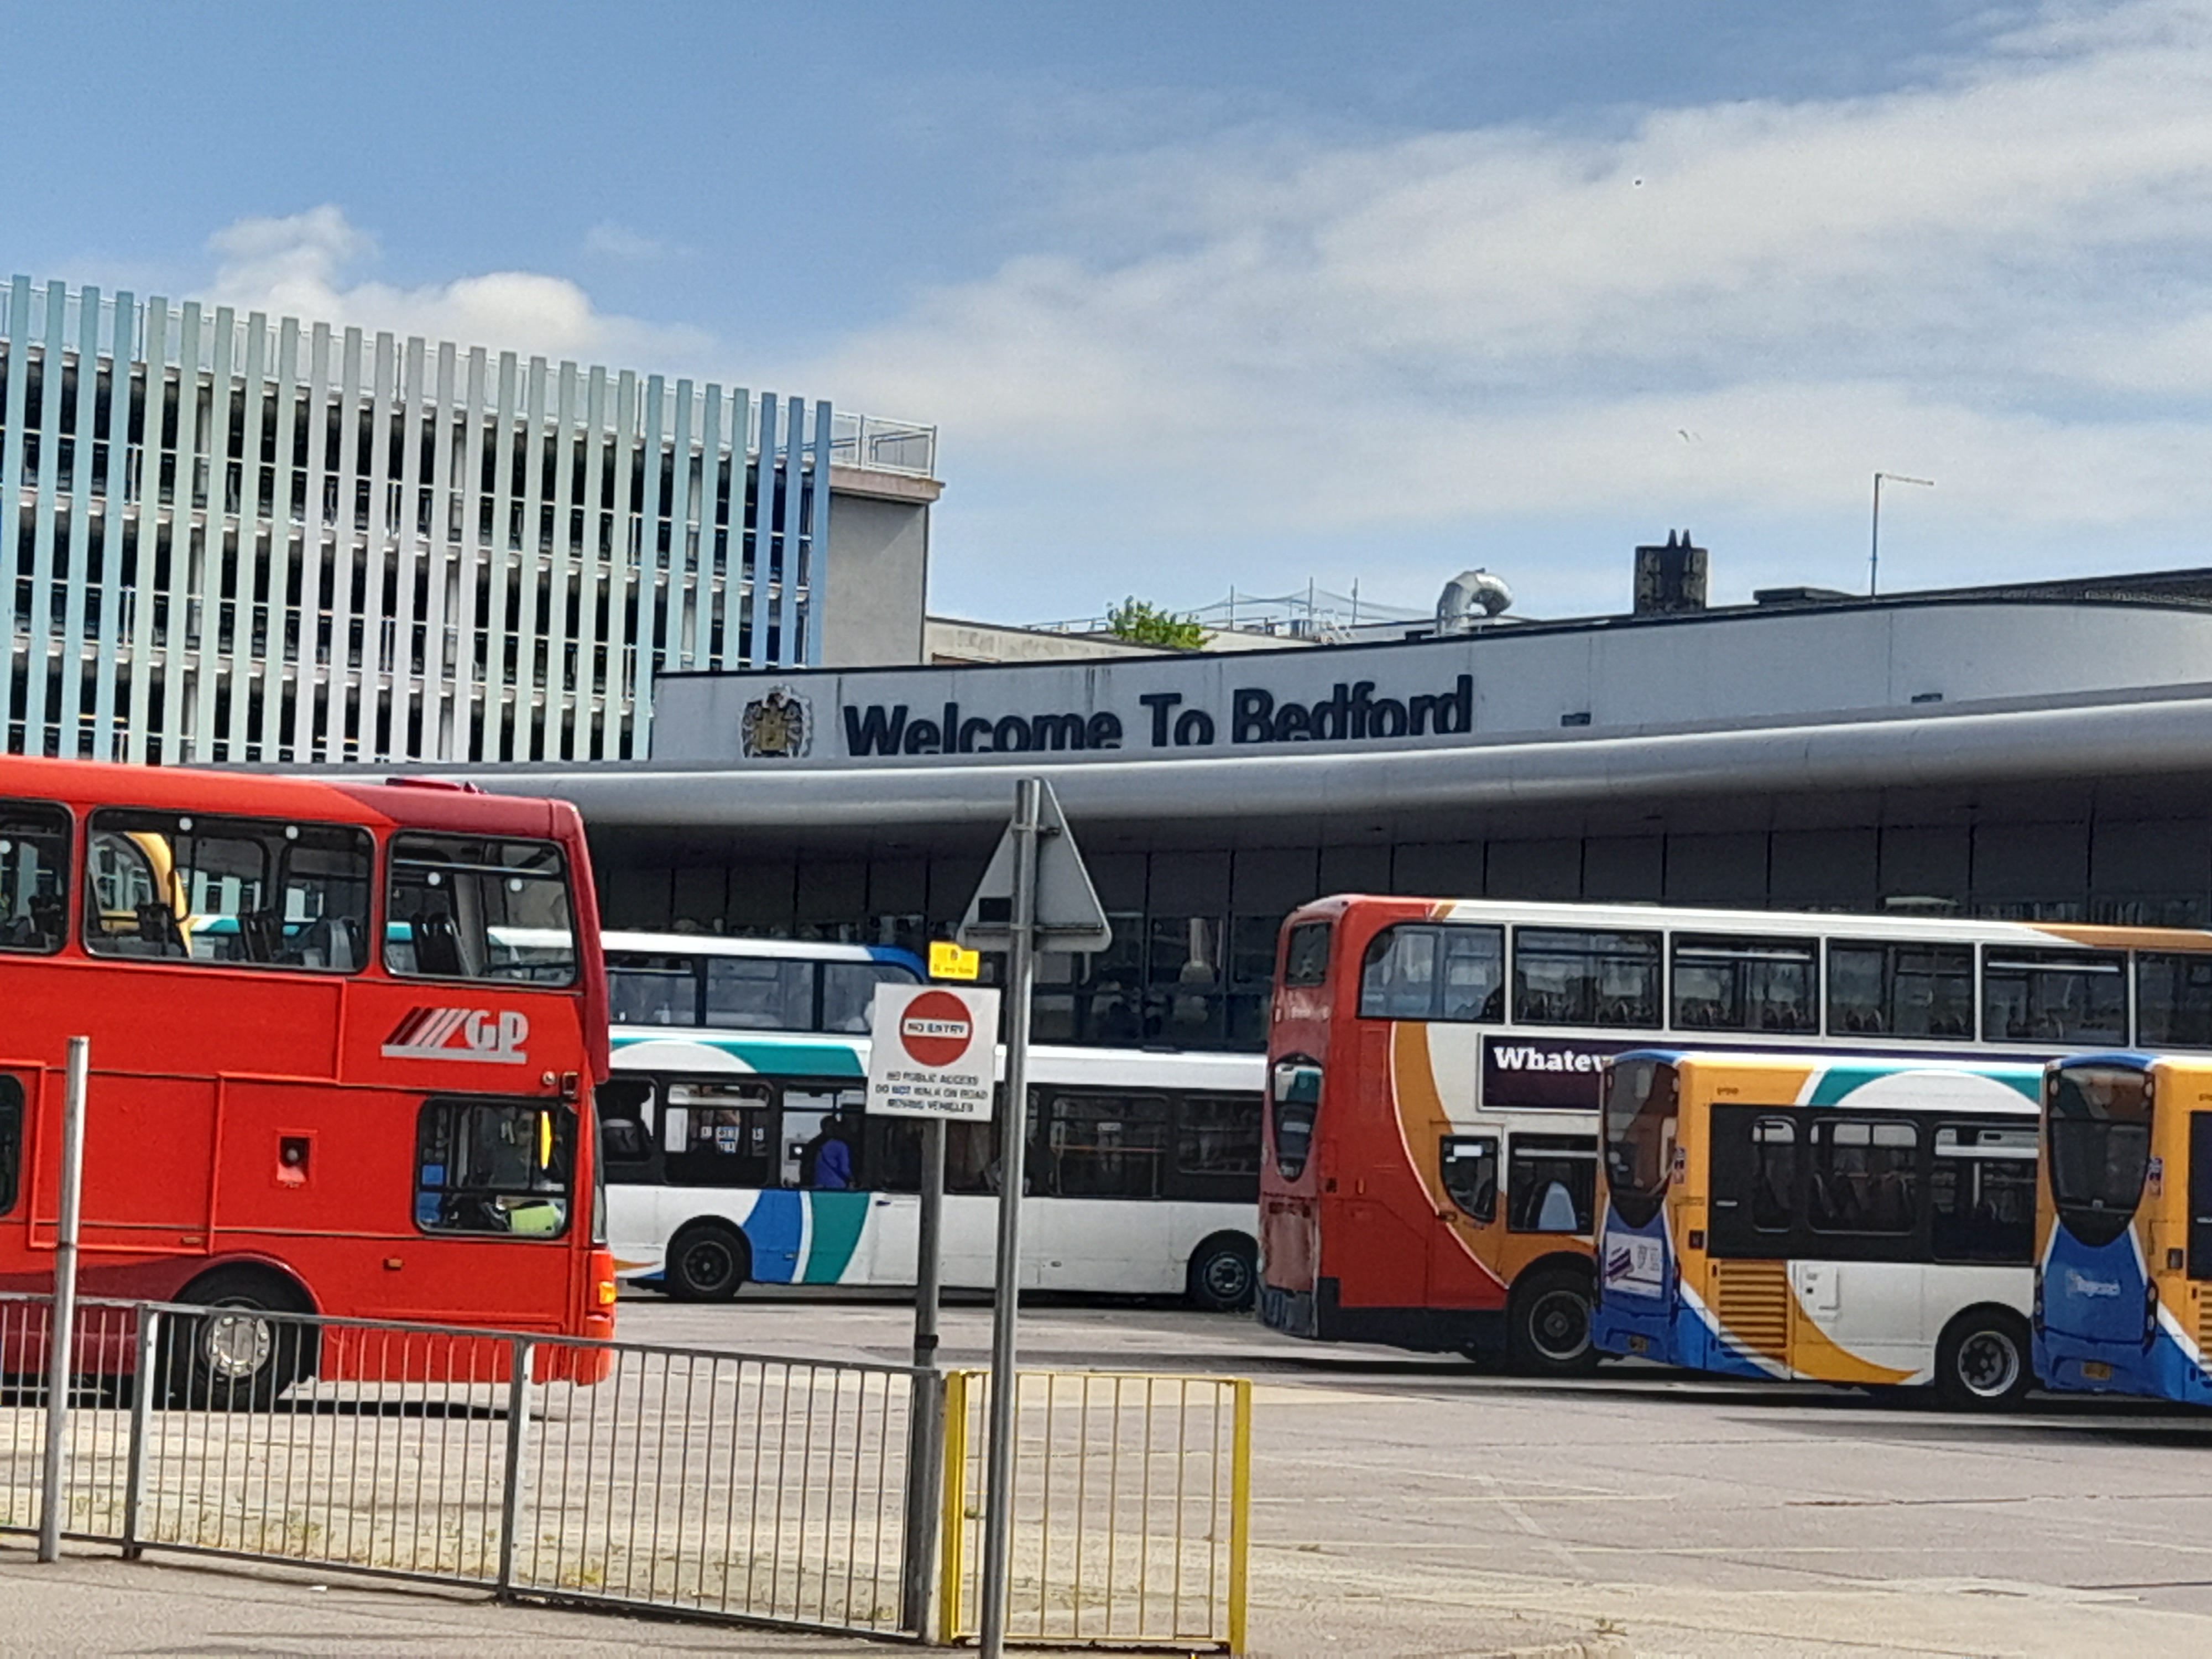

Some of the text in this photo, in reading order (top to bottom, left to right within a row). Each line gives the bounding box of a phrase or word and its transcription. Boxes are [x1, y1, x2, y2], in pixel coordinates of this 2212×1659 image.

[843, 674, 1473, 756] Welcome To Bedford
[907, 1022, 965, 1034] NO ENTRY
[875, 1084, 889, 1094] DO
